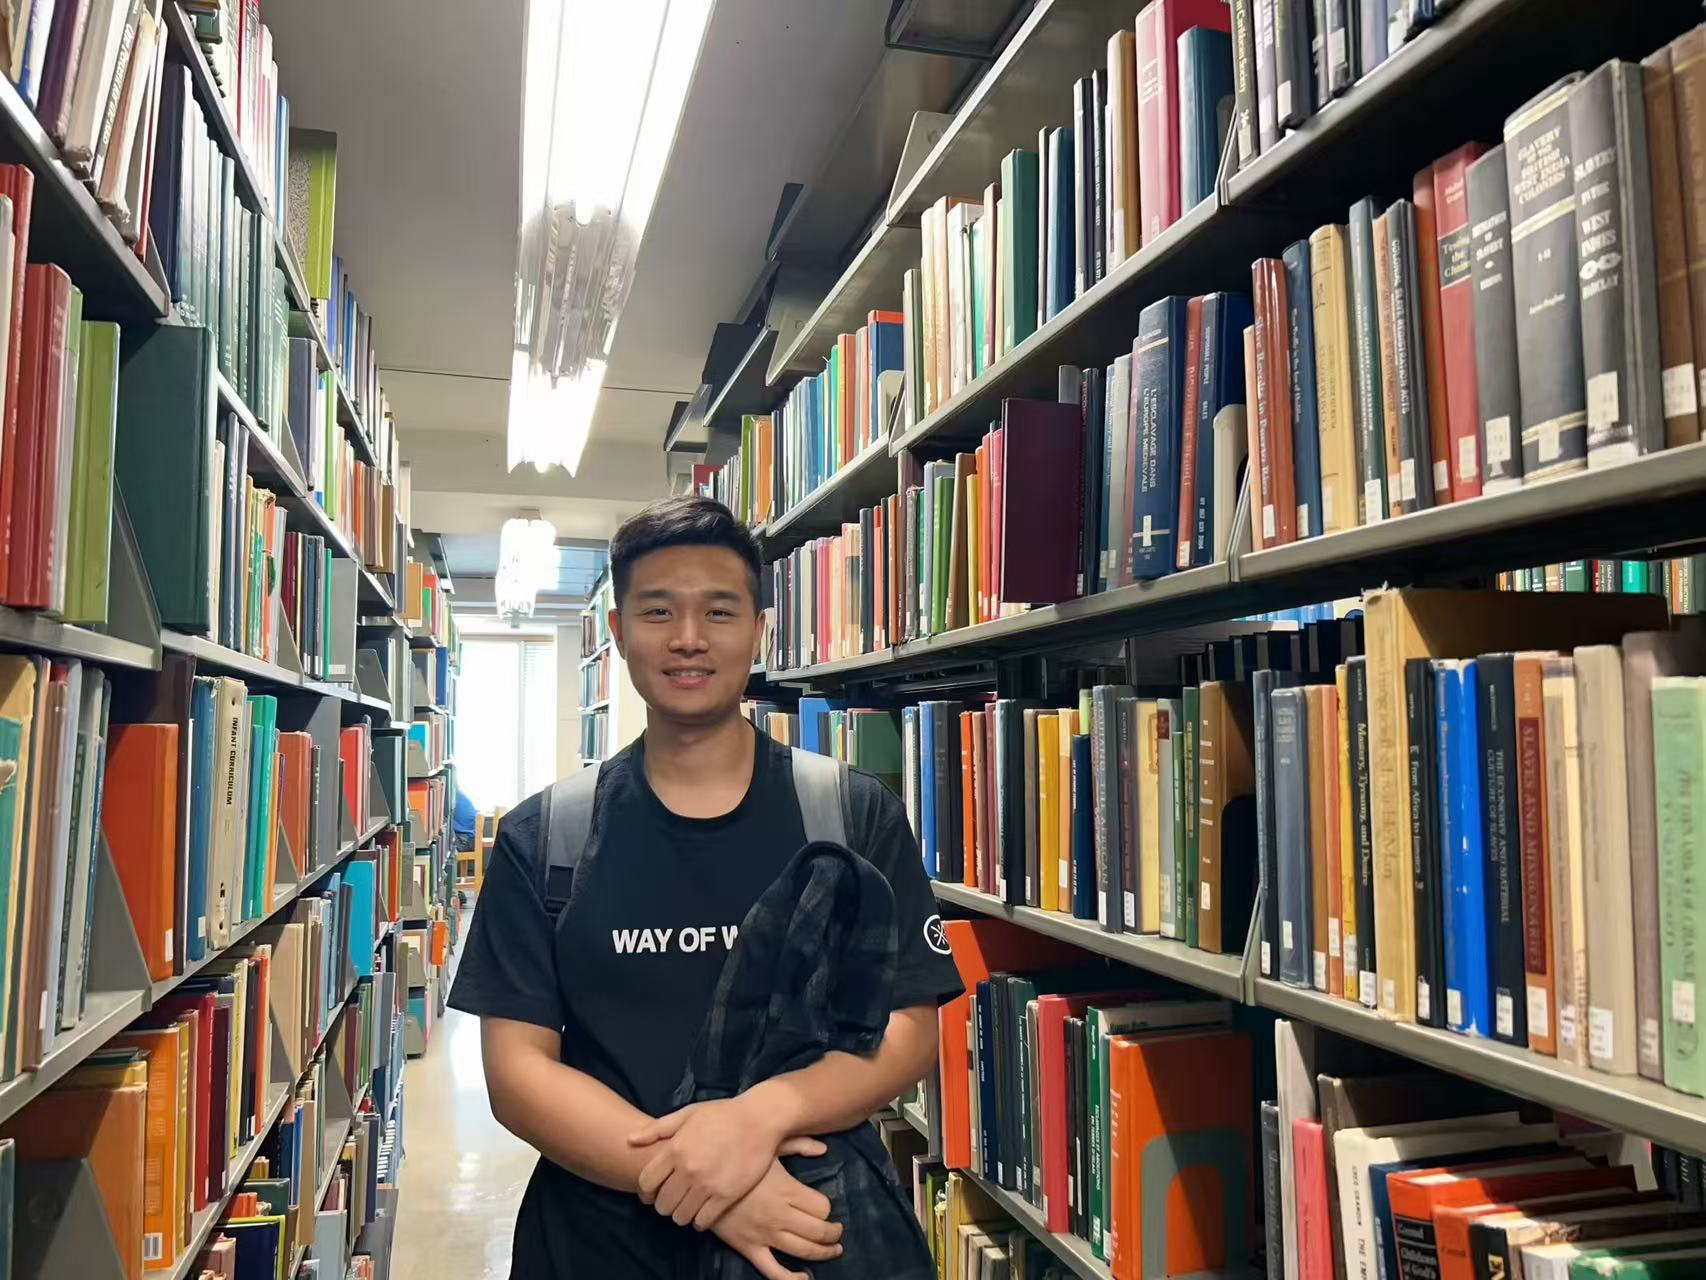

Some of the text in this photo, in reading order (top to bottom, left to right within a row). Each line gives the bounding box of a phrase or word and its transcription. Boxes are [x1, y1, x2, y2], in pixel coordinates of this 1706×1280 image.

[1238, 57, 1248, 93] Society
[1518, 126, 1561, 160] SLAVERY
[1574, 146, 1617, 182] SLAVERY
[1518, 168, 1566, 205] COLONIES
[1582, 209, 1612, 235] WEST
[1392, 240, 1402, 287] COLONIAL
[1254, 315, 1264, 348] Slave
[1396, 319, 1408, 387] REGISTRATION
[1258, 401, 1268, 415] in
[1400, 389, 1410, 415] ACTS
[1149, 388, 1158, 457] L'ESCLAVAGE
[226, 717, 238, 806] INFANT CURRICULUM
[1411, 761, 1420, 786] From
[1487, 749, 1496, 801] CULTURE
[1495, 750, 1504, 772] THE
[1357, 722, 1371, 886] Mastery, Tyranny, and Desire
[1412, 789, 1422, 819] Africa
[1488, 804, 1496, 817] OF
[1413, 822, 1421, 832] to
[1498, 838, 1508, 866] AND
[1522, 725, 1543, 968] SLAVES AND MISSIONARIES
[1500, 866, 1510, 923] MATERIAL
[612, 928, 673, 954] WAY
[679, 927, 716, 952] OF
[1354, 1190, 1362, 1226] GRANDIN
[1358, 1238, 1366, 1256] THE
